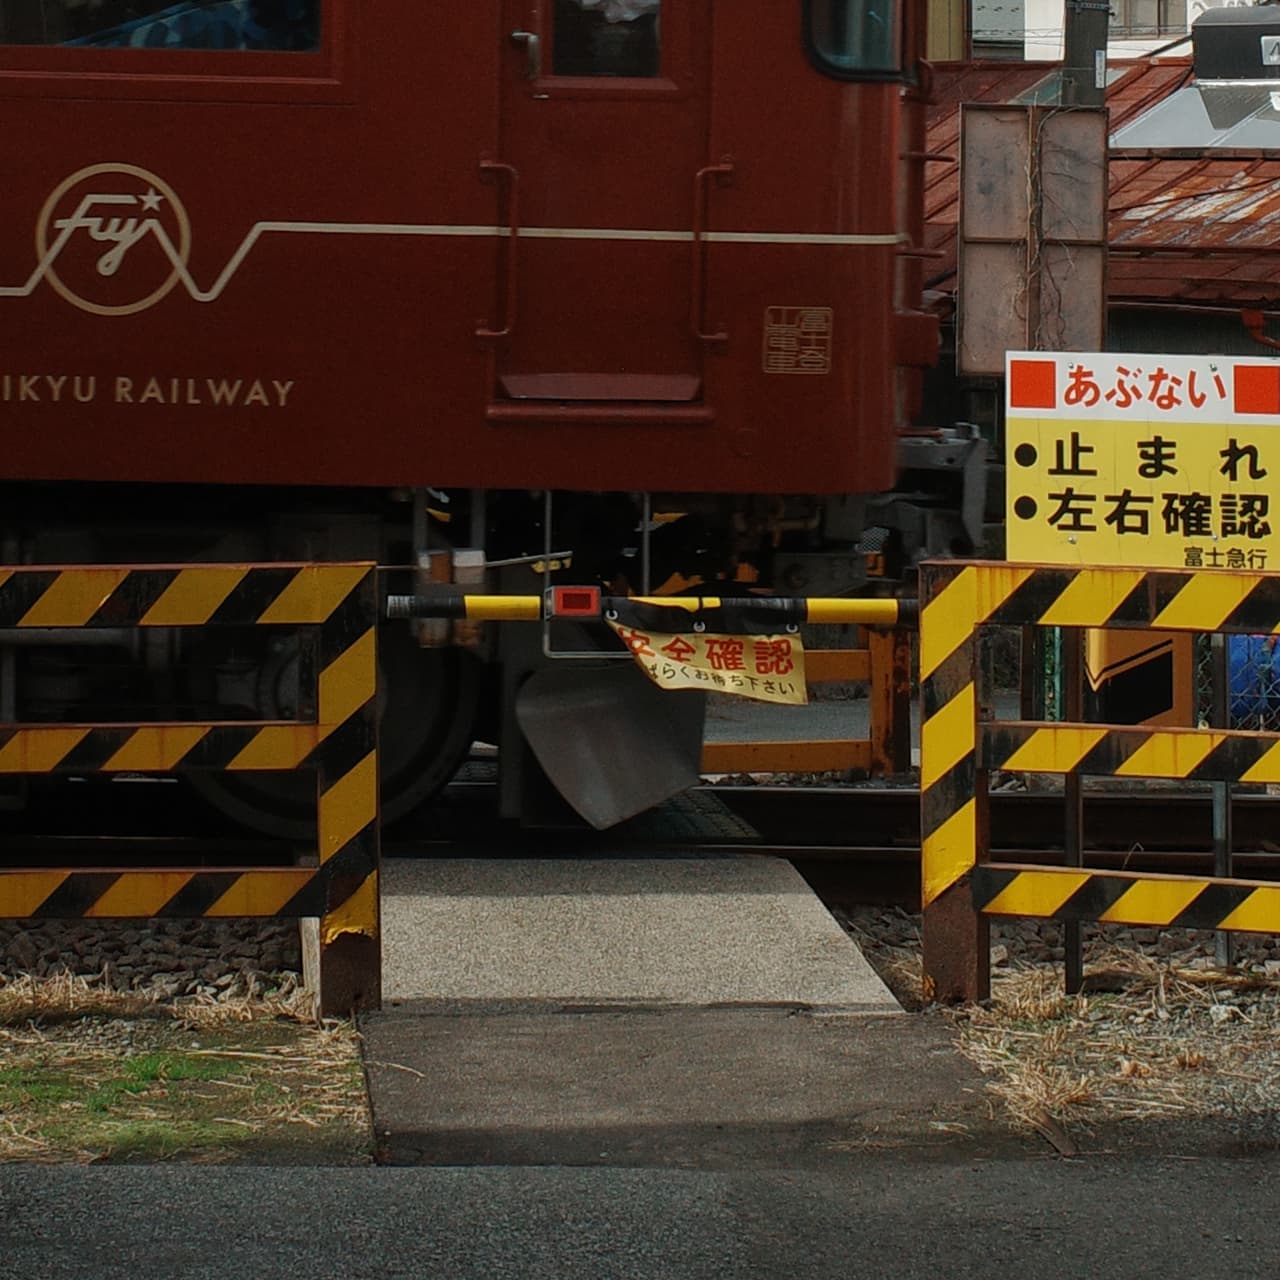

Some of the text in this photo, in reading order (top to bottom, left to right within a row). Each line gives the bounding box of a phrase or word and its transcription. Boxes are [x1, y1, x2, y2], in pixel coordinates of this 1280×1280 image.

[116, 376, 295, 406] RAILWAY
[1064, 364, 1227, 410] あぶない
[1047, 431, 1268, 482] 止まれ
[1047, 487, 1272, 540] 左右確認
[1183, 546, 1268, 570] 富士急行
